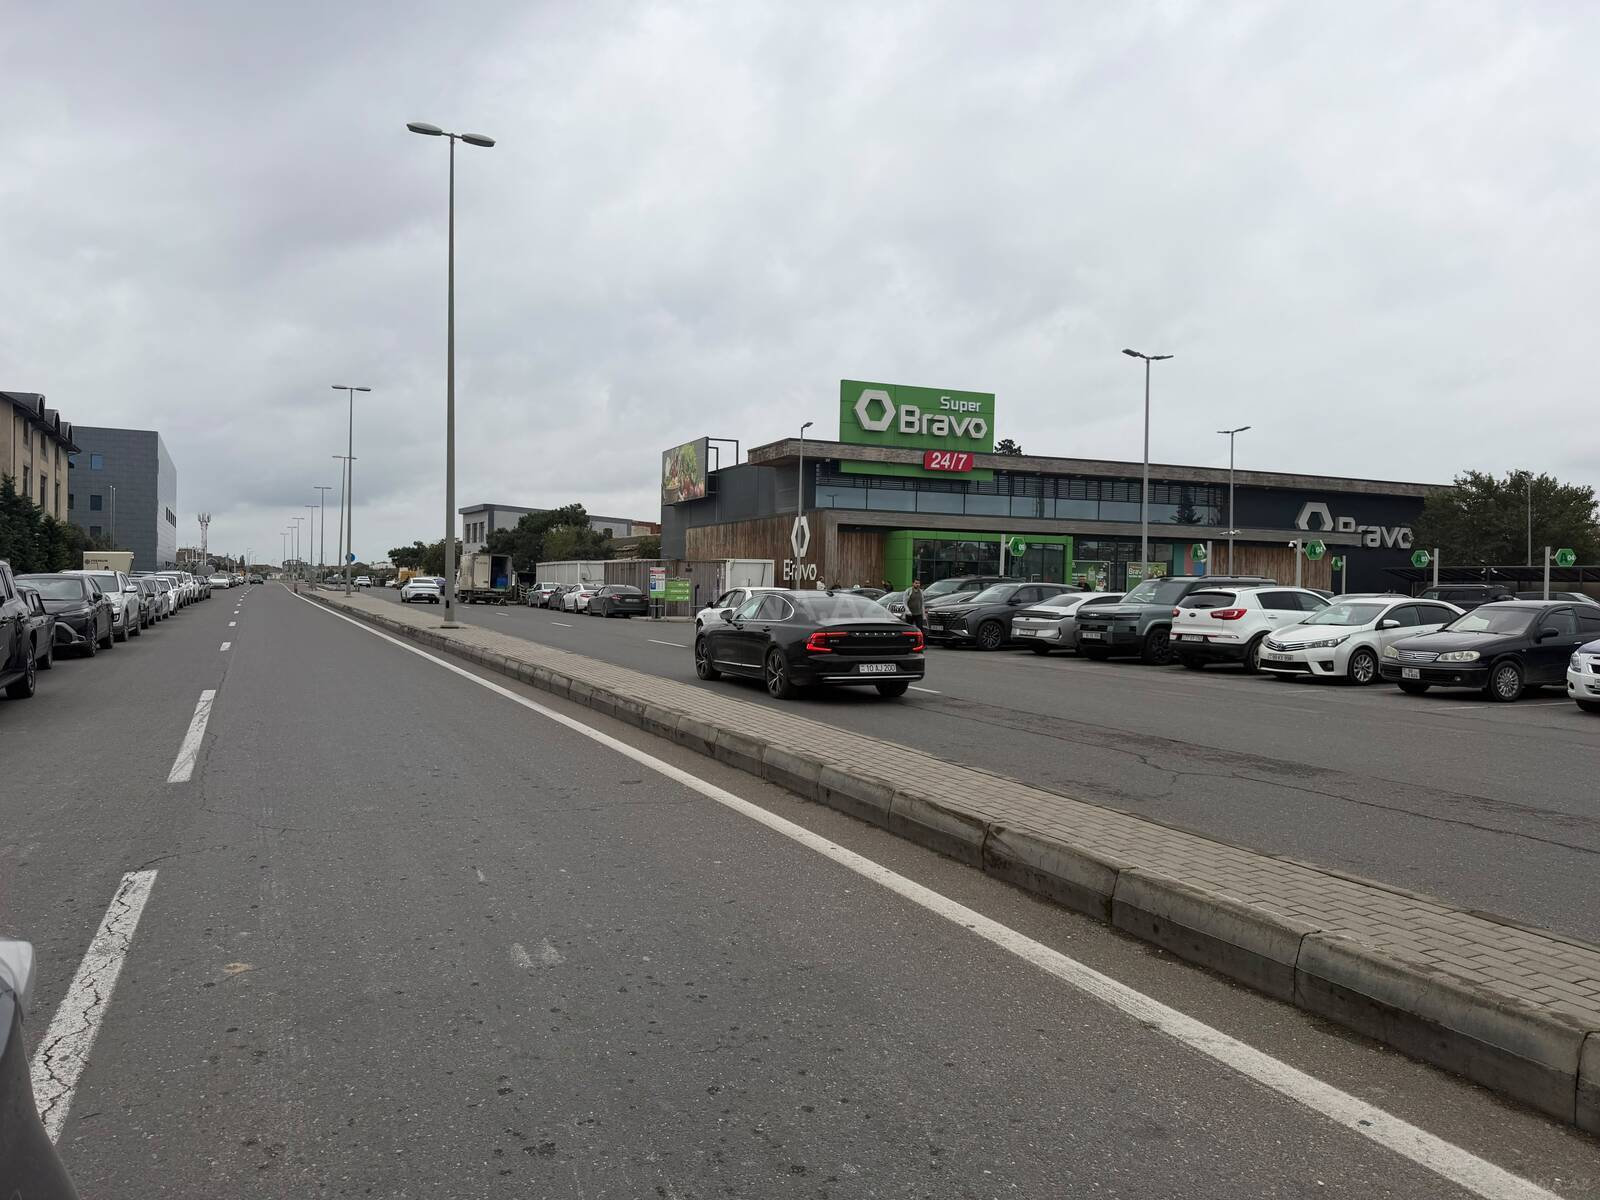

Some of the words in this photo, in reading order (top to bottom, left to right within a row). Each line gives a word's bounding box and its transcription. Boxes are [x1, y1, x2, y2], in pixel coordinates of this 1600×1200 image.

[940, 396, 982, 413] Super
[899, 404, 988, 439] Bravo
[930, 452, 968, 469] 24/7
[866, 664, 874, 672] 10
[884, 664, 896, 672] 200
